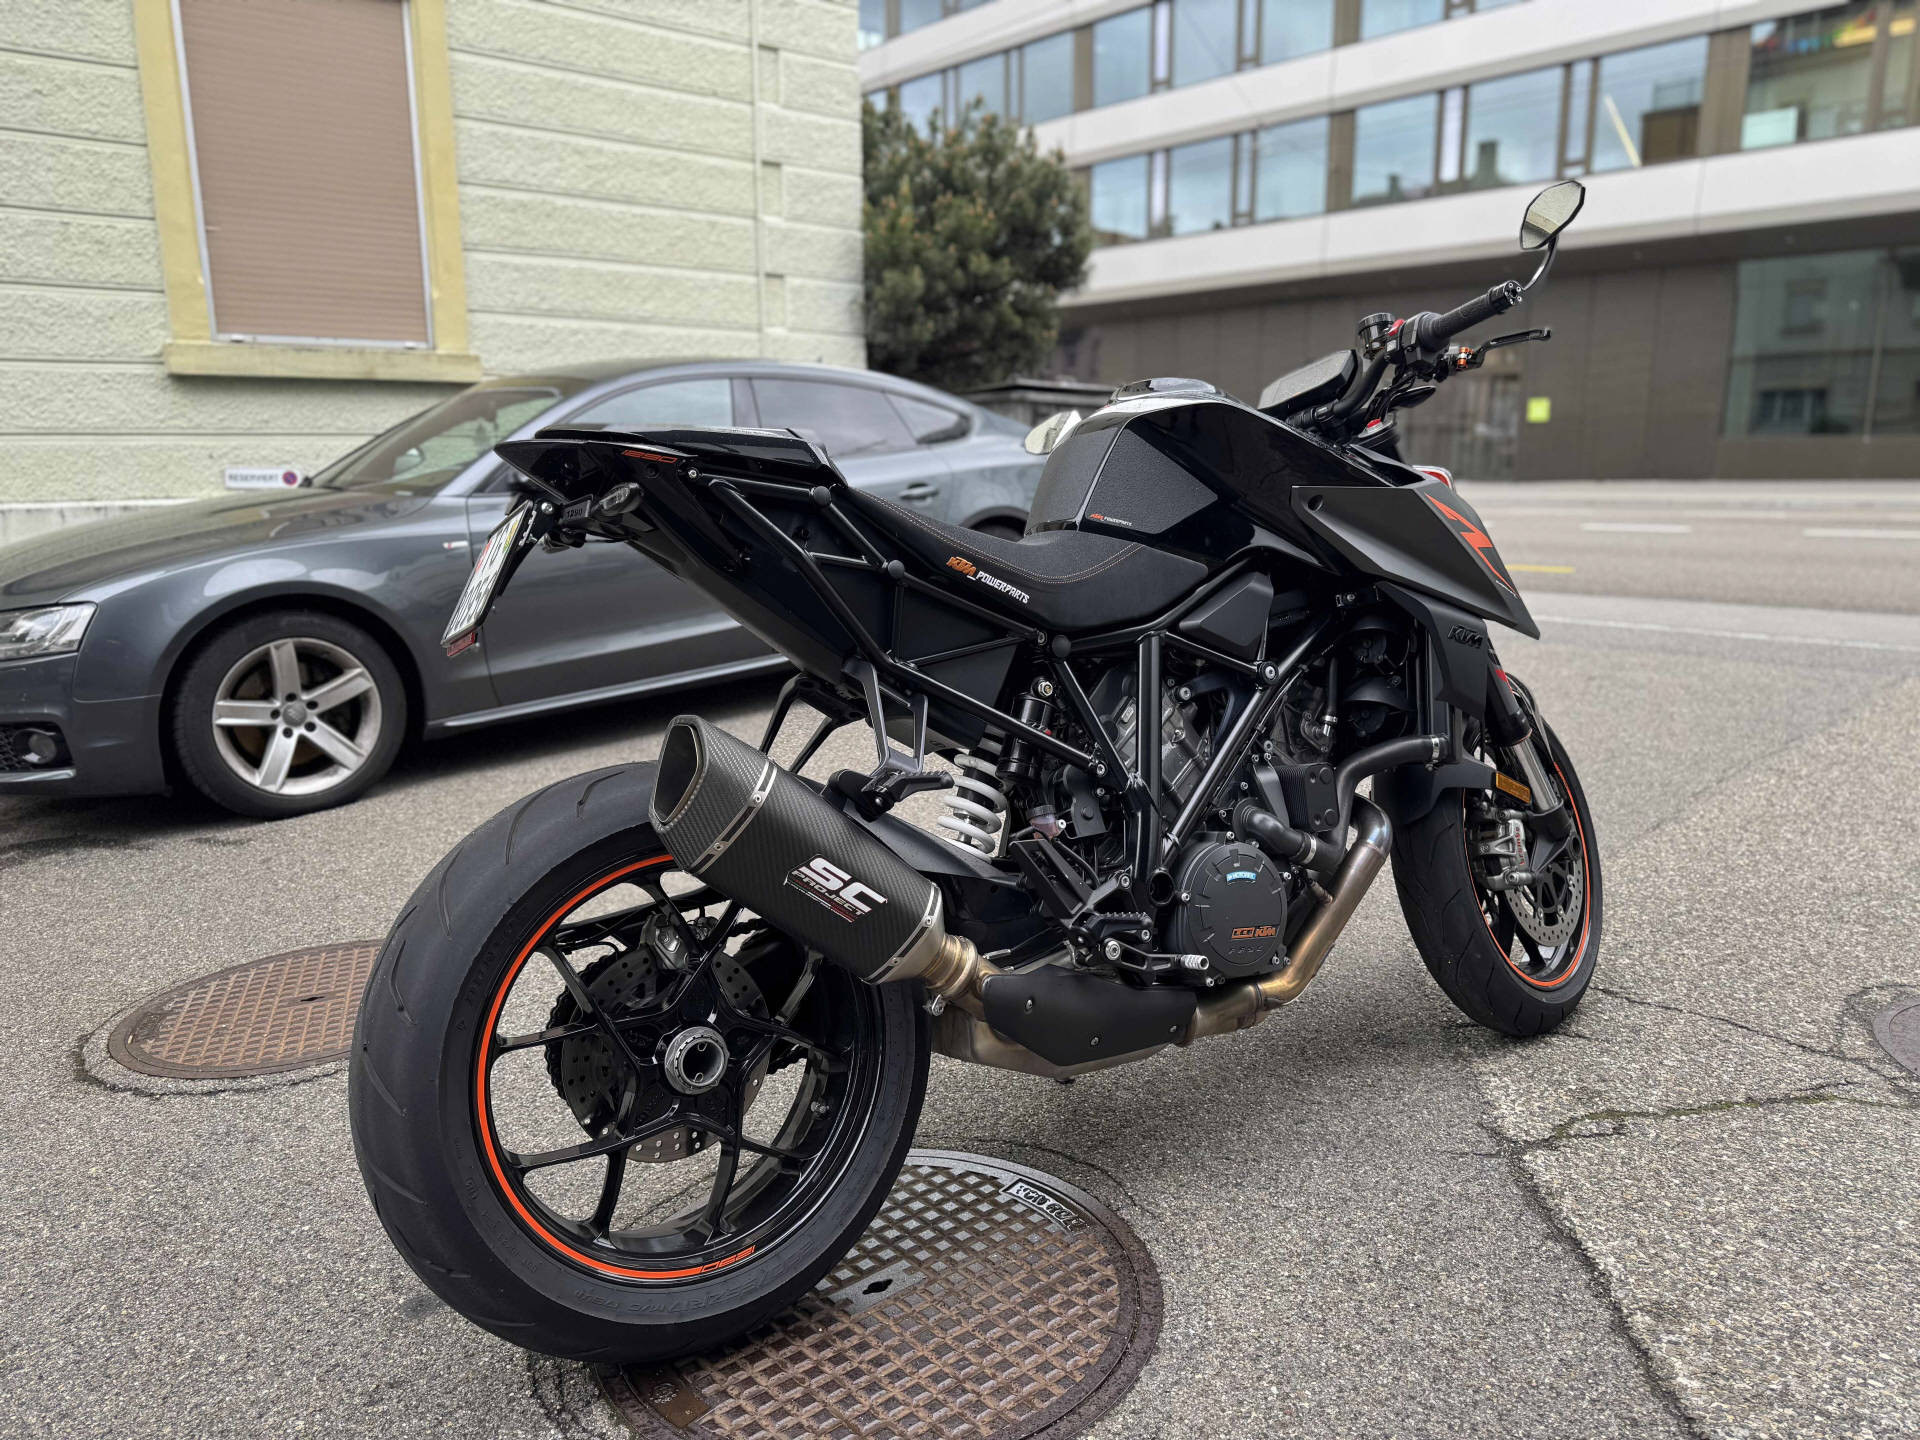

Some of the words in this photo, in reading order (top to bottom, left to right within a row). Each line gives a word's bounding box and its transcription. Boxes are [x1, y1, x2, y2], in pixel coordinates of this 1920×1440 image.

[621, 450, 678, 464] 1290
[946, 556, 977, 577] KTM
[976, 570, 1030, 604] POWERPARTS
[1447, 624, 1483, 648] KTM
[791, 870, 866, 916] PROJECT
[798, 857, 888, 913] SC
[1255, 926, 1276, 937] KTM
